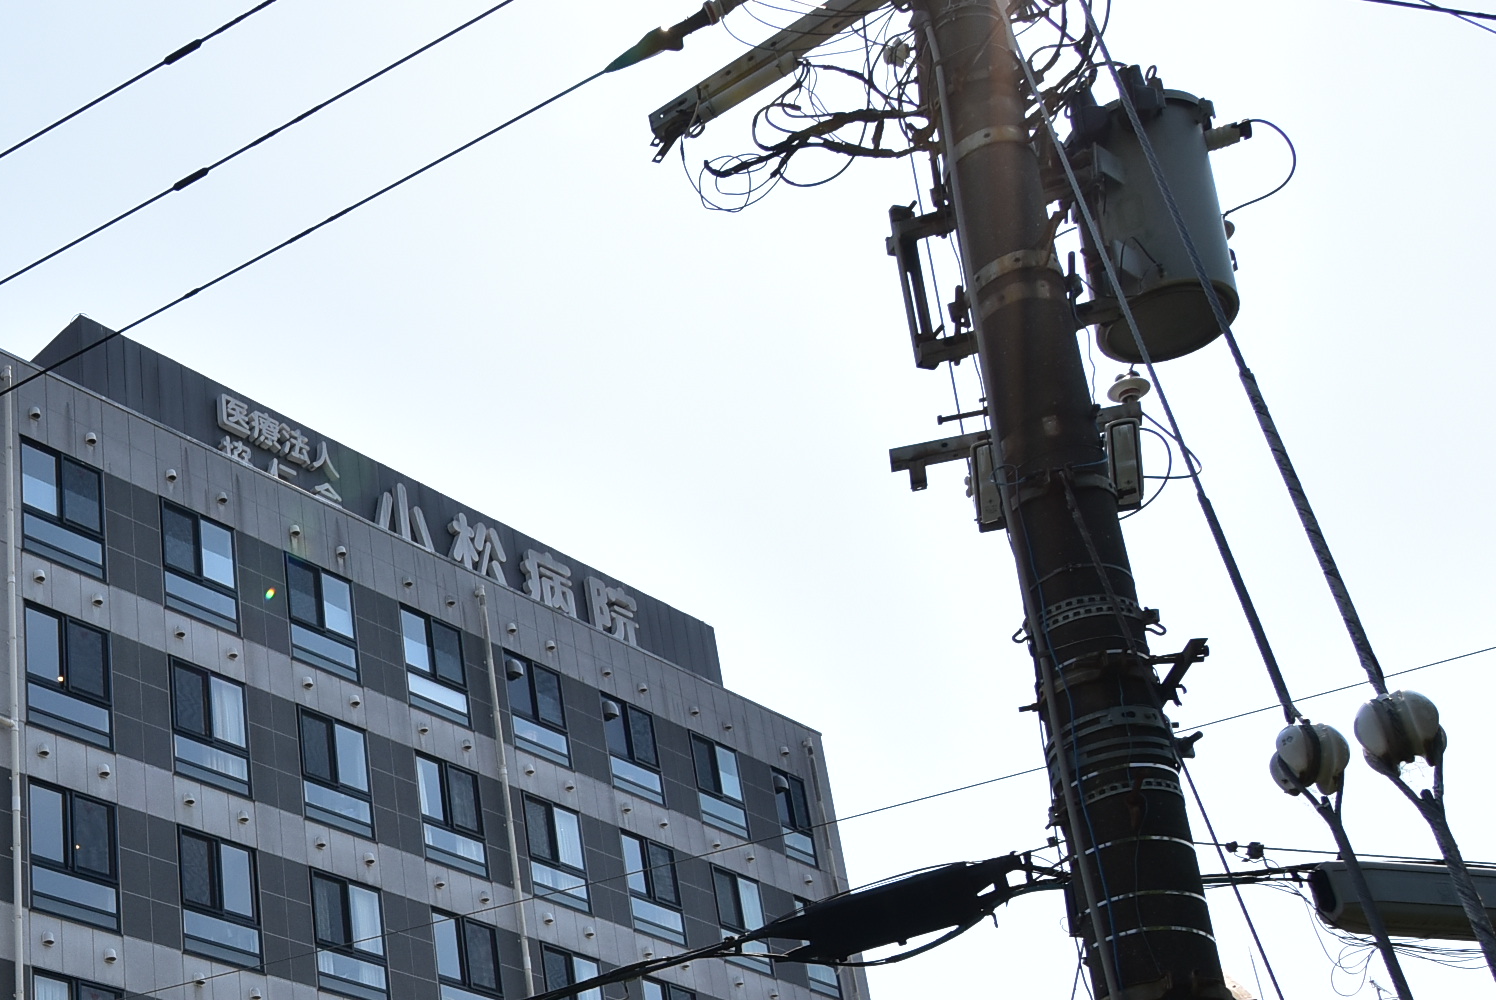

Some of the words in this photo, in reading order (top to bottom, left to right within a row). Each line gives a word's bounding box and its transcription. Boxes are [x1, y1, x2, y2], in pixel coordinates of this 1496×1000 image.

[217, 393, 340, 481] 医療法人
[374, 482, 640, 646] 小松病院
